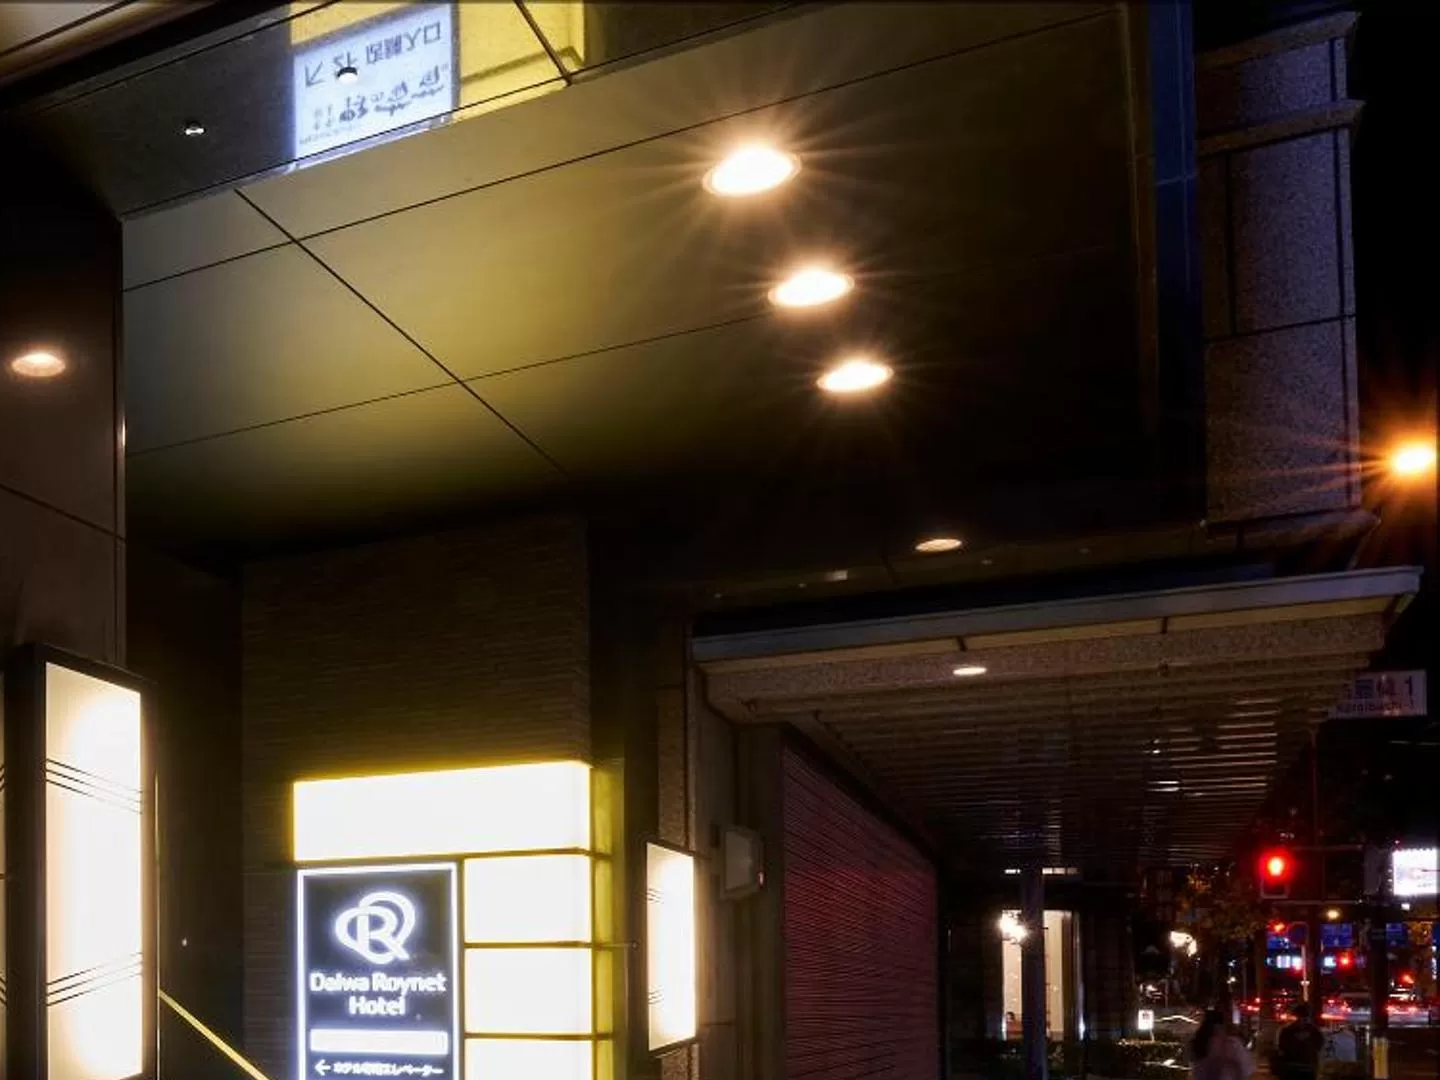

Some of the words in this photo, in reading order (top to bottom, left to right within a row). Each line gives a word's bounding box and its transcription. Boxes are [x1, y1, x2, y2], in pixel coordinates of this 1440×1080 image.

[310, 972, 369, 992] Daiwa
[372, 972, 446, 996] Roynet
[349, 996, 406, 1015] Hotel
